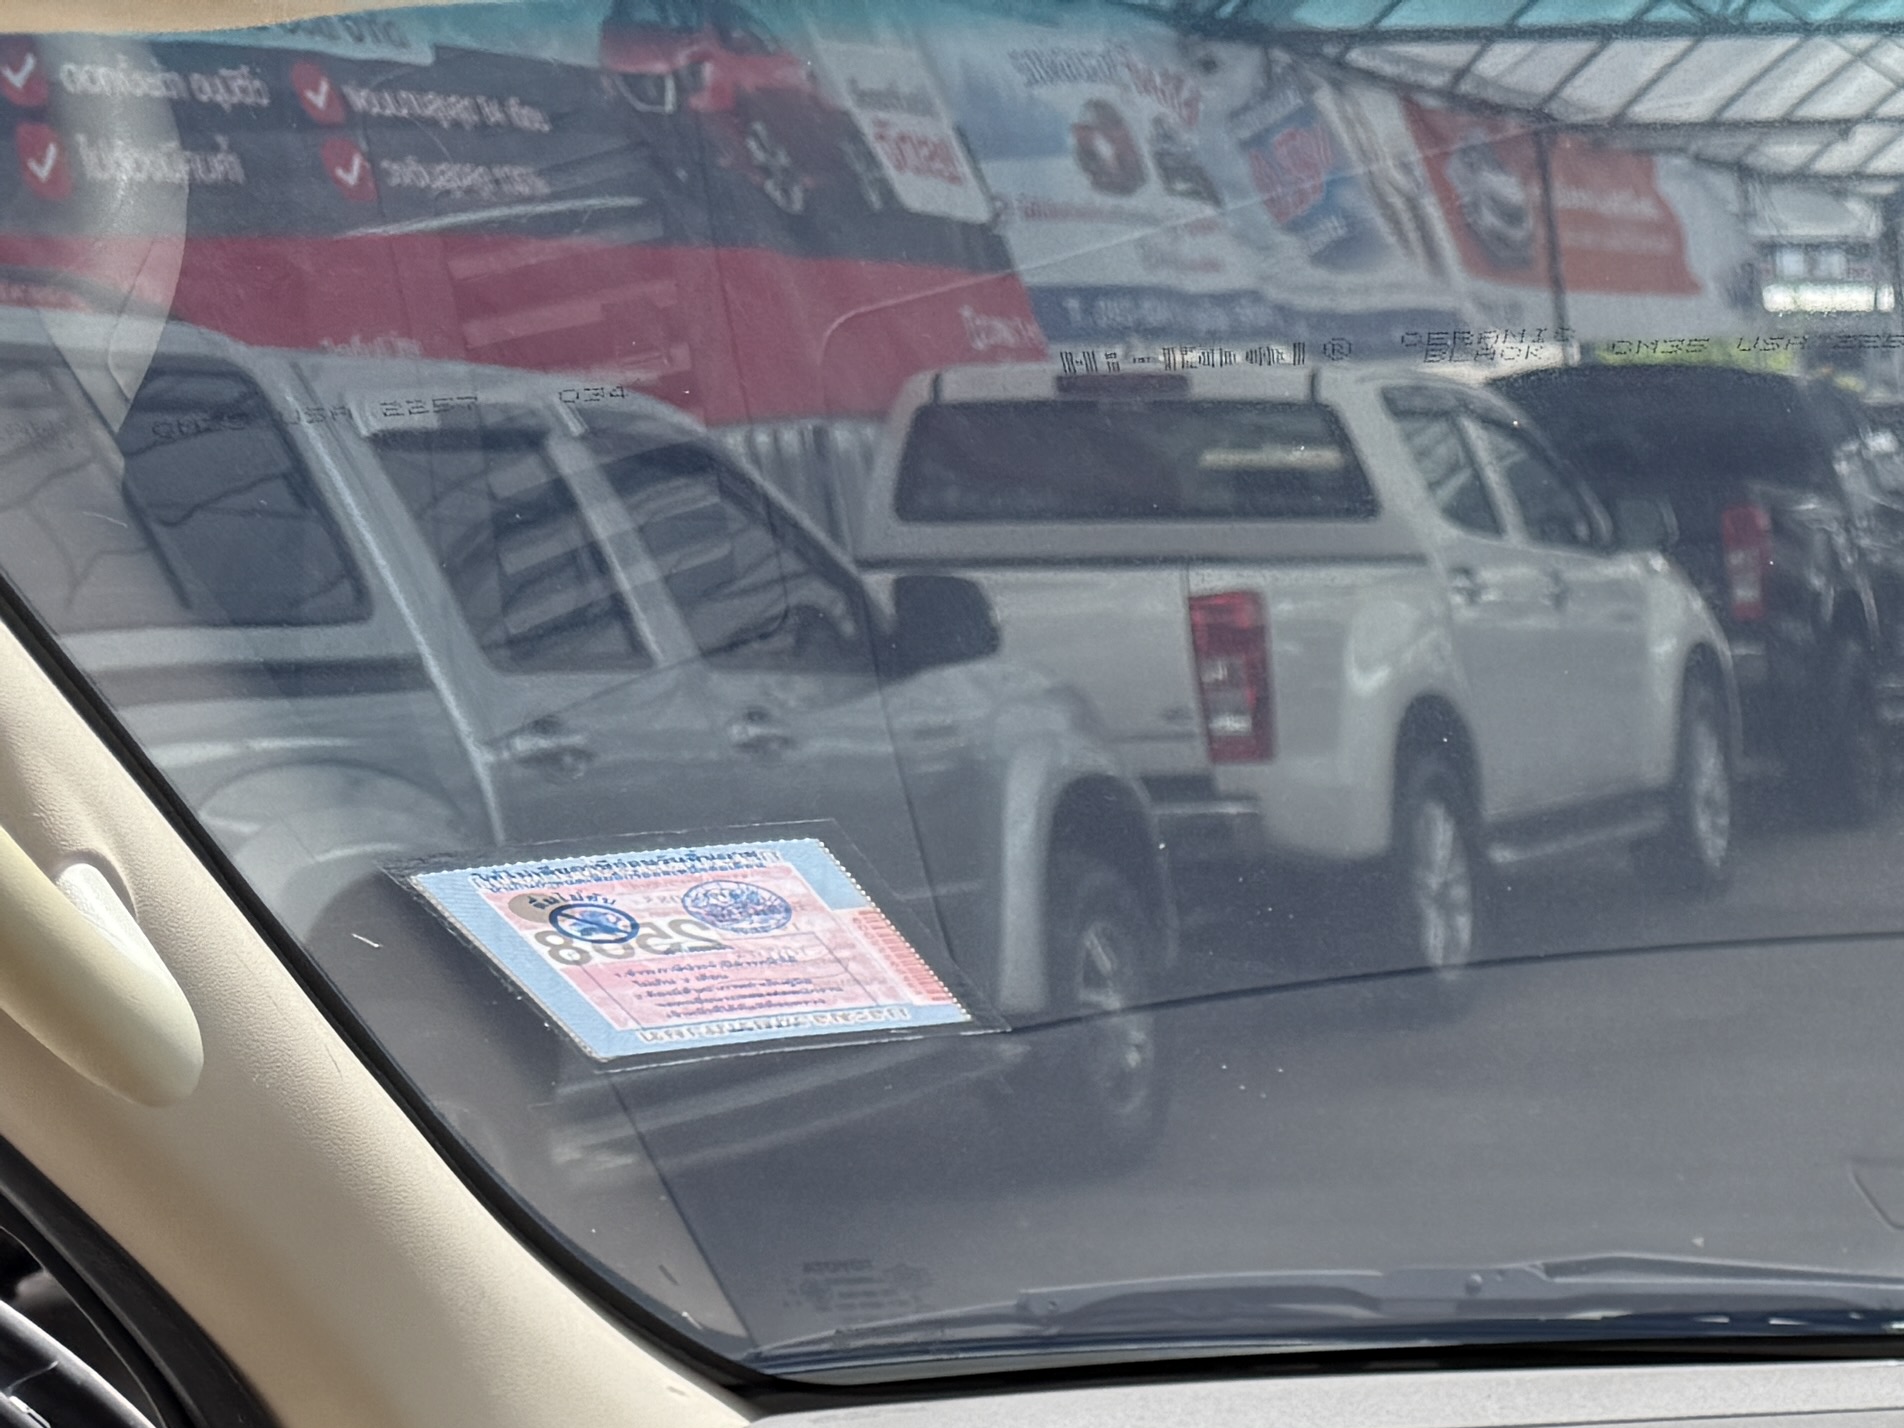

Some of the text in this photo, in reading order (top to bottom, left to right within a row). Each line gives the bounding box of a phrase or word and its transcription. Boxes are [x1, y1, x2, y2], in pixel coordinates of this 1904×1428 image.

[1400, 328, 1577, 347] CERAMIC
[1736, 335, 1808, 353] USA
[1424, 345, 1543, 363] BLACK
